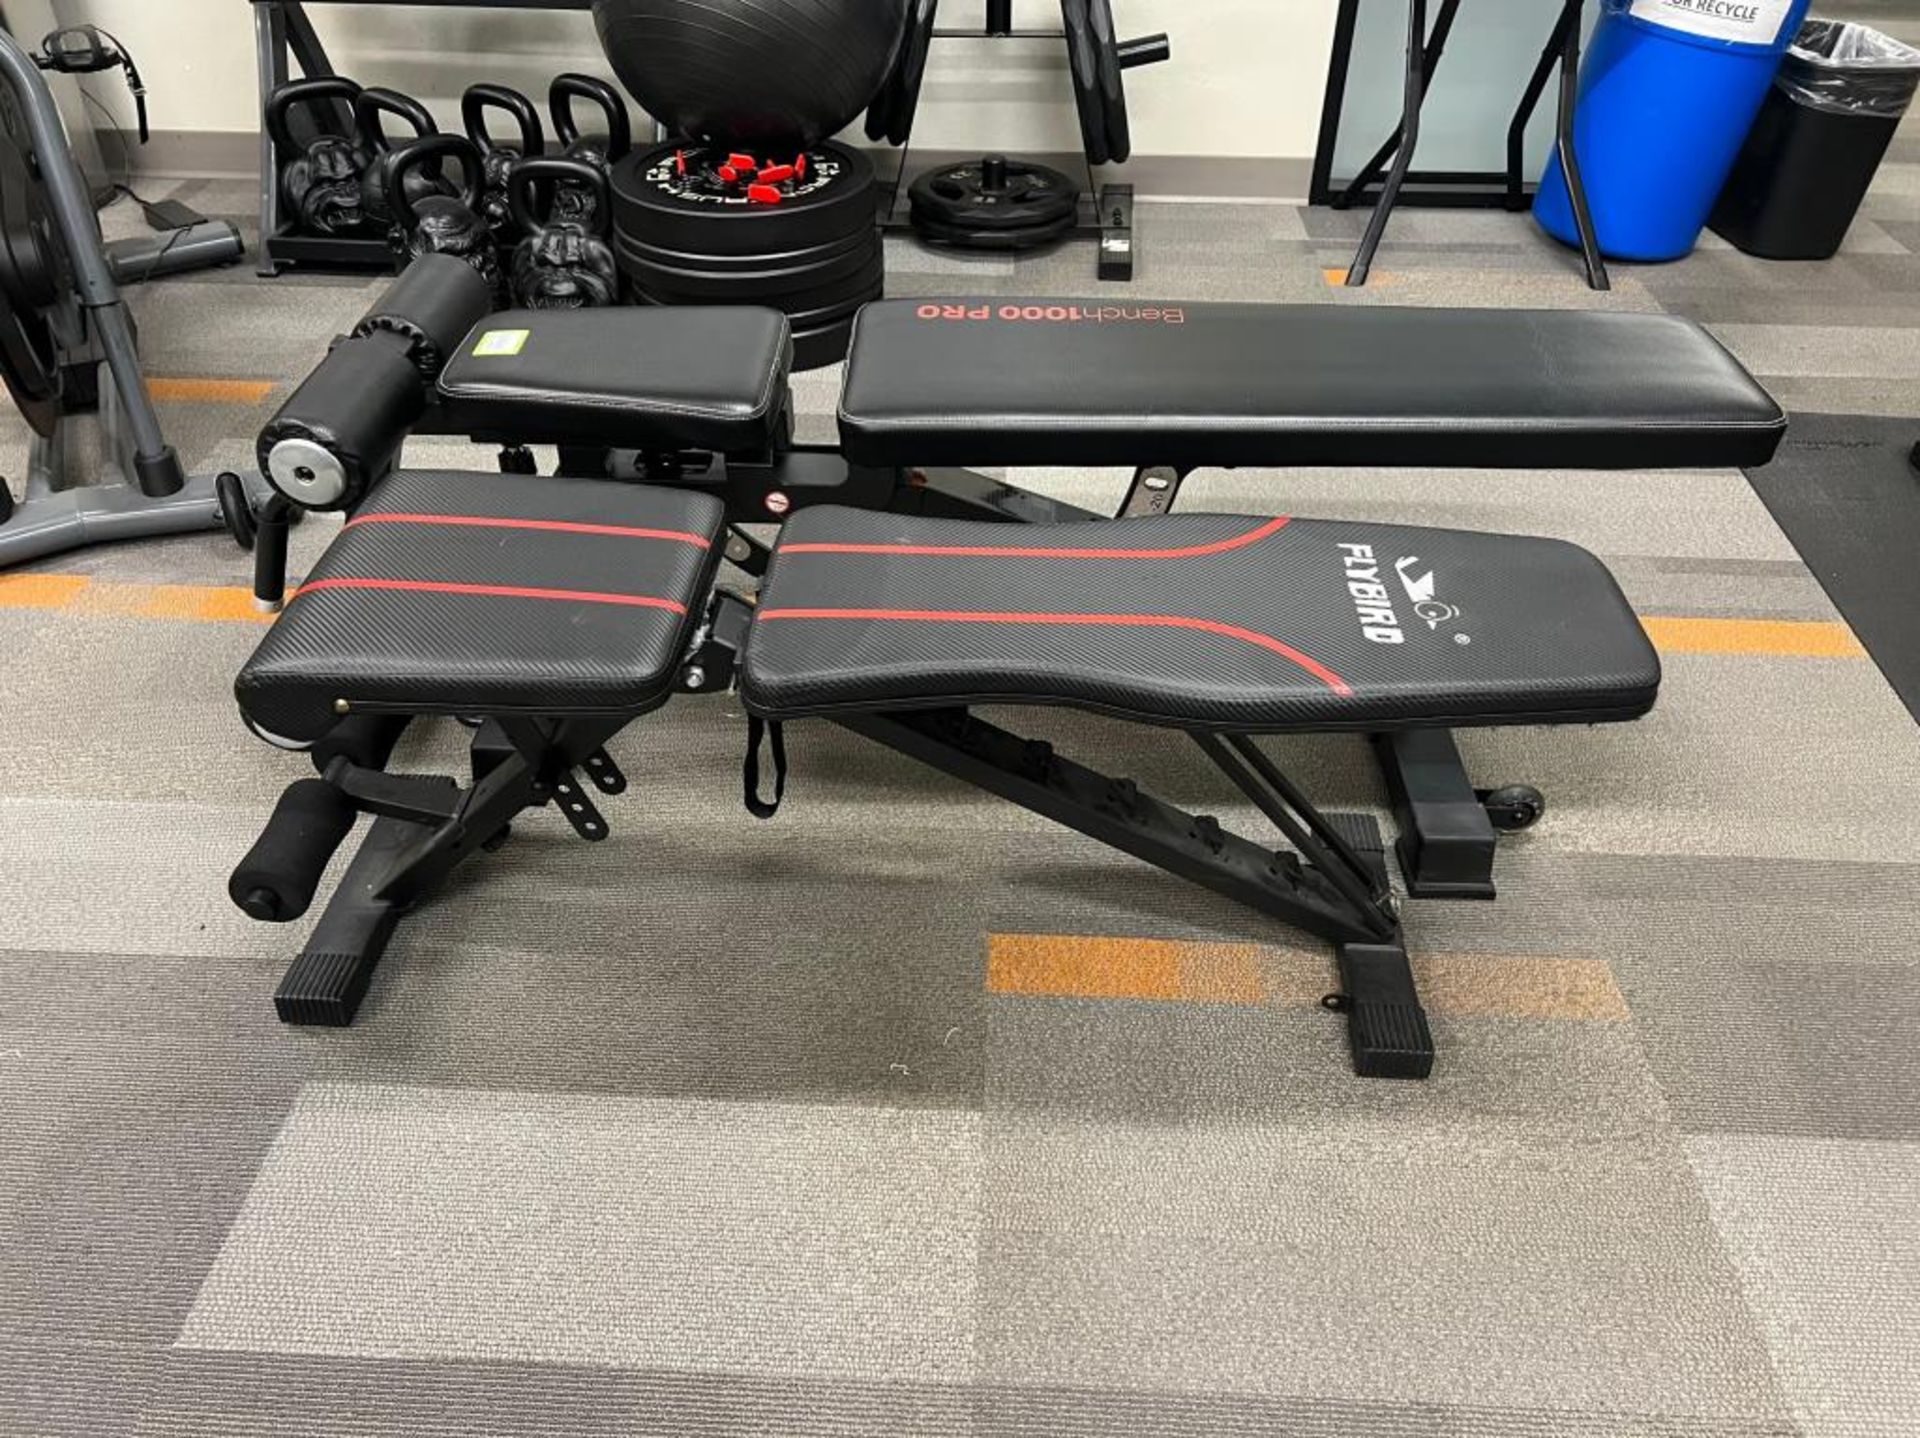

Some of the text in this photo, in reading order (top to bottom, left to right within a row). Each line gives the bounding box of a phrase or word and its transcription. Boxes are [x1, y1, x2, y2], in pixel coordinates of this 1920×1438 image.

[1696, 0, 1759, 20] RECYCLE
[916, 304, 1185, 324] Bench1000 PRO
[1336, 543, 1405, 644] FLYBIRD
